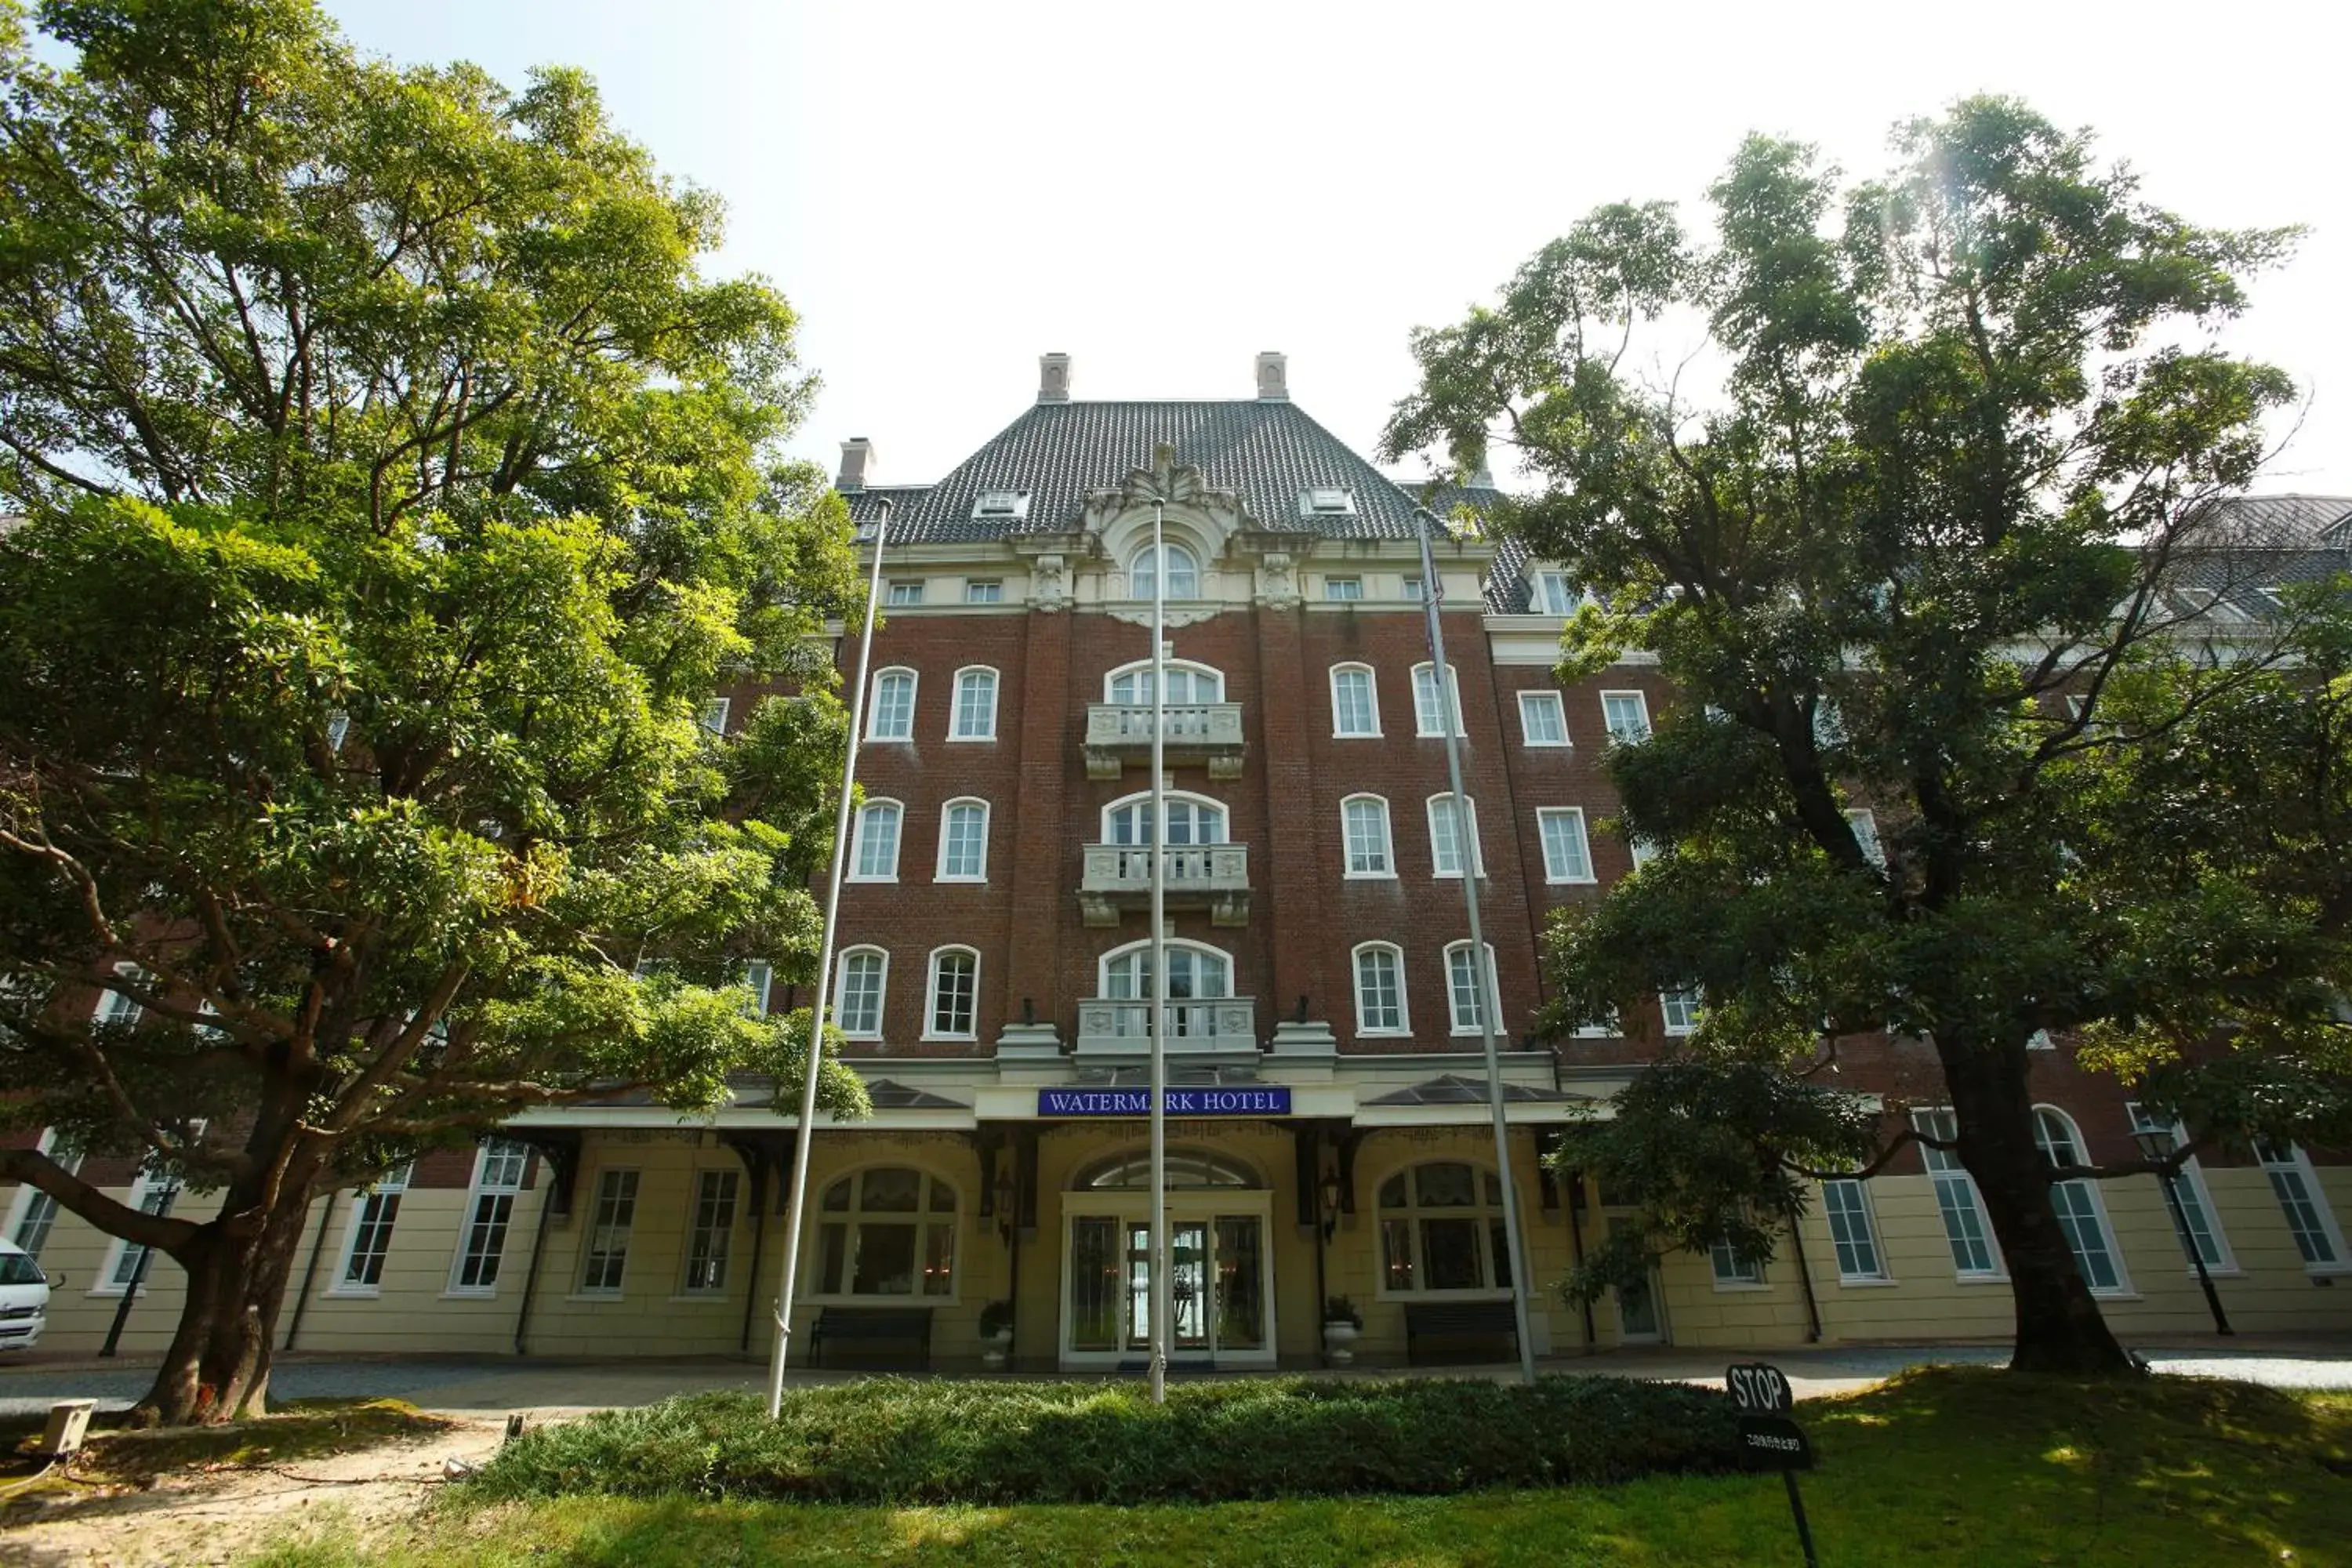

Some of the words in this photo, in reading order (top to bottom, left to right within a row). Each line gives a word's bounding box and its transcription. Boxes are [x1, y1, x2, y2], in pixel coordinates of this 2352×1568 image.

[1049, 1093, 1194, 1112] WATERMRK
[1203, 1092, 1280, 1110] HOTEL
[1731, 1367, 1782, 1410] STOP
